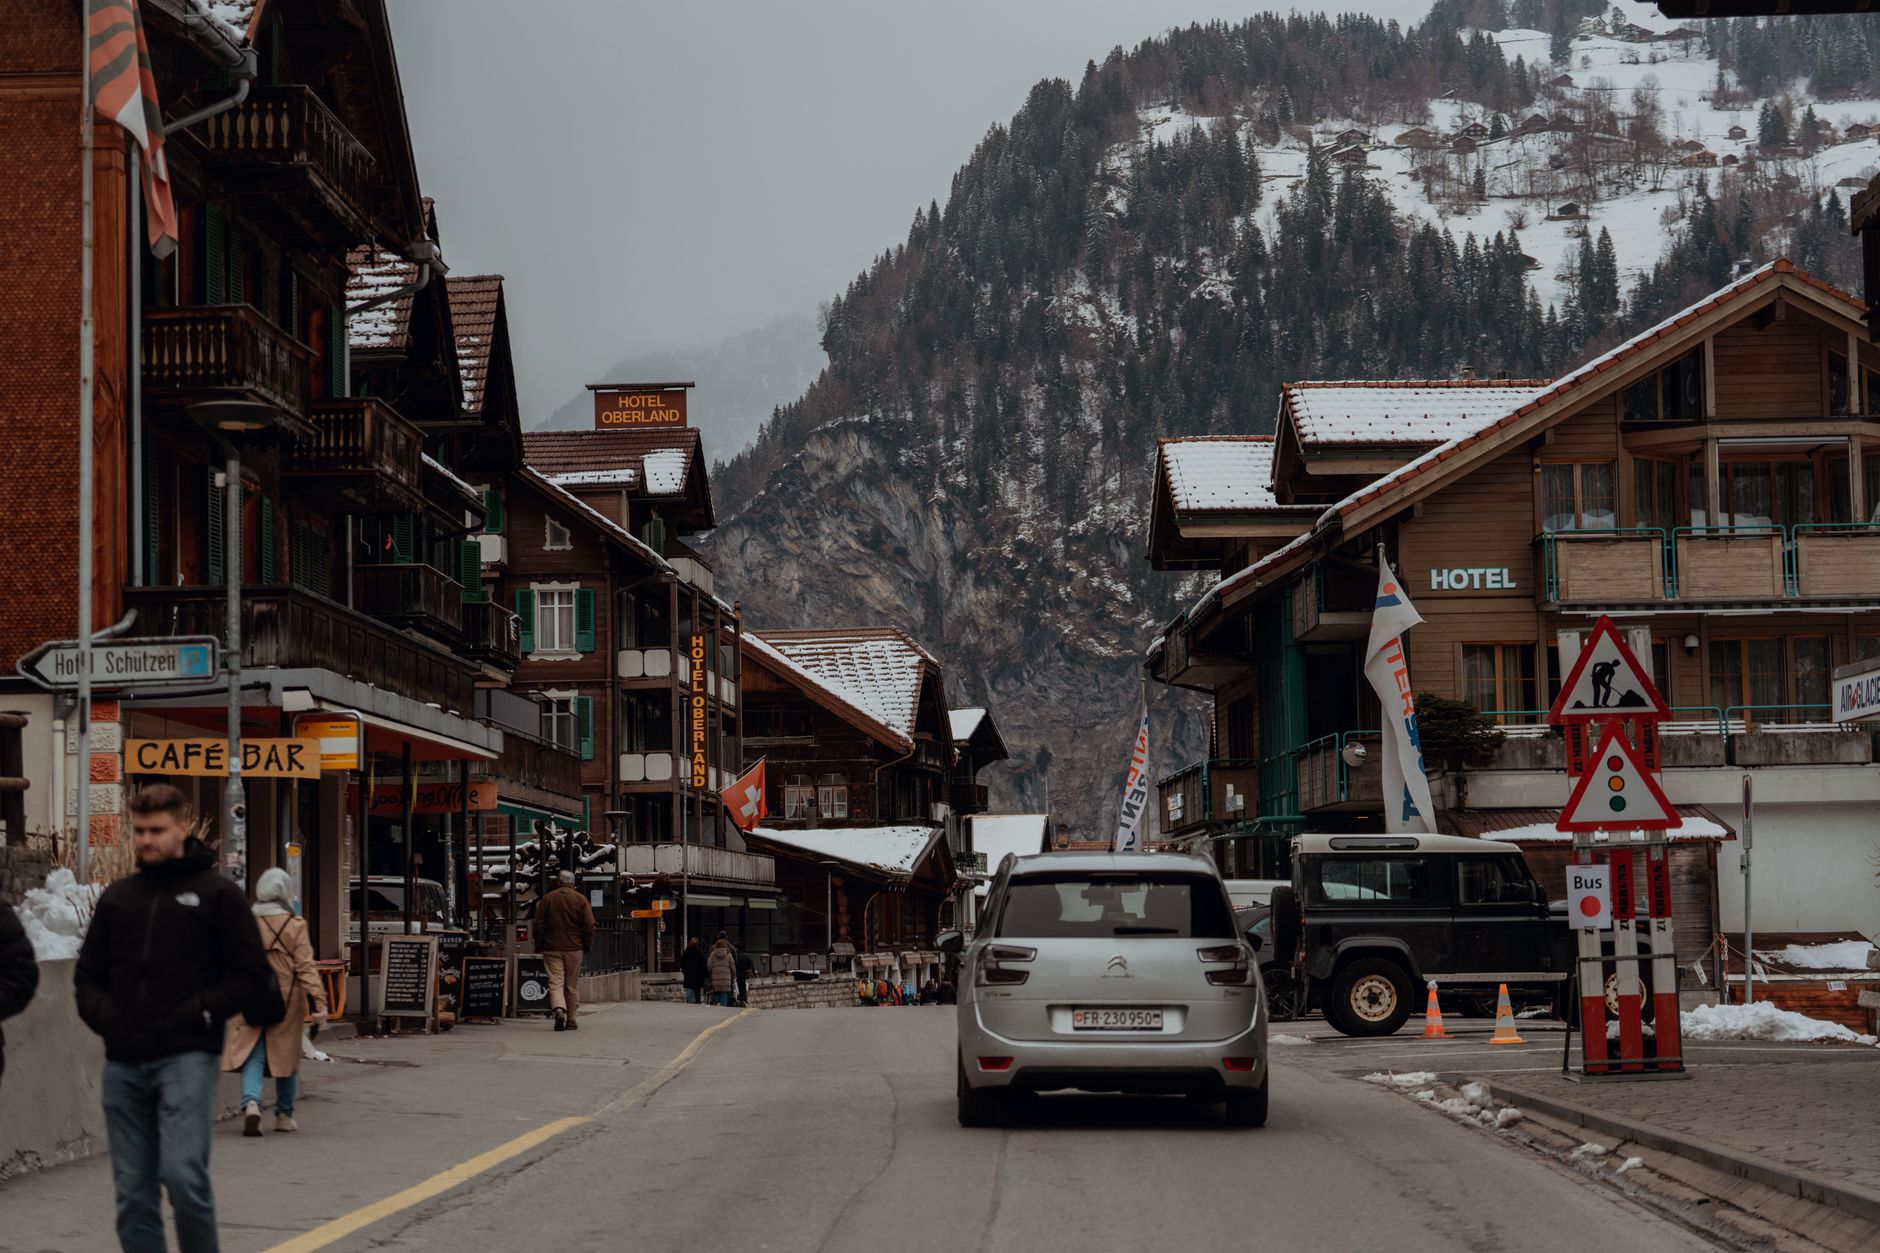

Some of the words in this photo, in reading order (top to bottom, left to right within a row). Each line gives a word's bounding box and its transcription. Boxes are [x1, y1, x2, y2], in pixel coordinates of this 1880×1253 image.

[619, 395, 666, 408] HOTEL
[601, 409, 680, 424] OBERLAND
[1430, 567, 1518, 591] HOTEL
[55, 652, 94, 676] Hotl
[105, 651, 176, 674] Schützen
[691, 635, 705, 692] HOTEL
[692, 696, 706, 788] OBERLAND
[137, 742, 224, 770] CAFÉ
[242, 743, 305, 771] BAR
[1573, 875, 1603, 890] Bus
